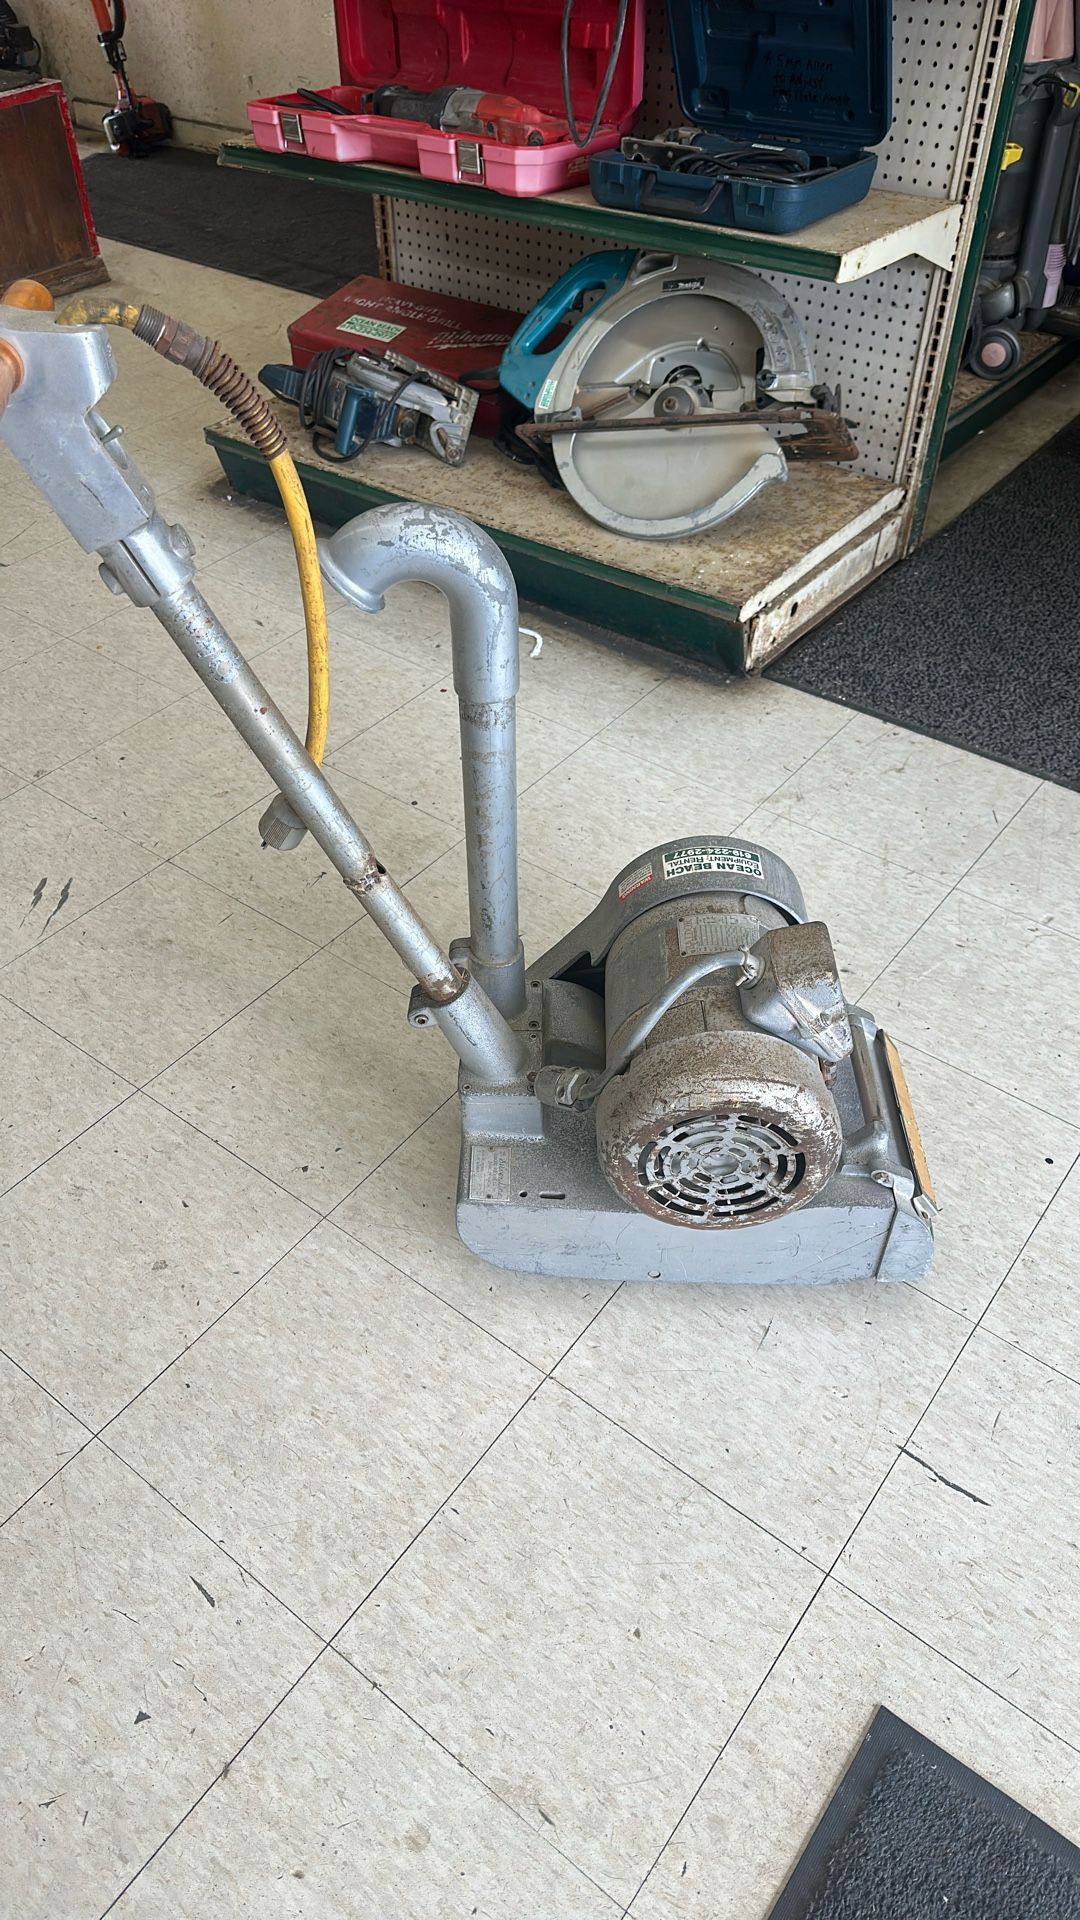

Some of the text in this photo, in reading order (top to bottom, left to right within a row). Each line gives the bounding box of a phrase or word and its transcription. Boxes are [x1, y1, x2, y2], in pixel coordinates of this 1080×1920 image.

[673, 848, 752, 859] 619-224-2977
[667, 856, 759, 869] EQUIPMENT RENTAL
[666, 862, 762, 877] OCEAN BEACH
